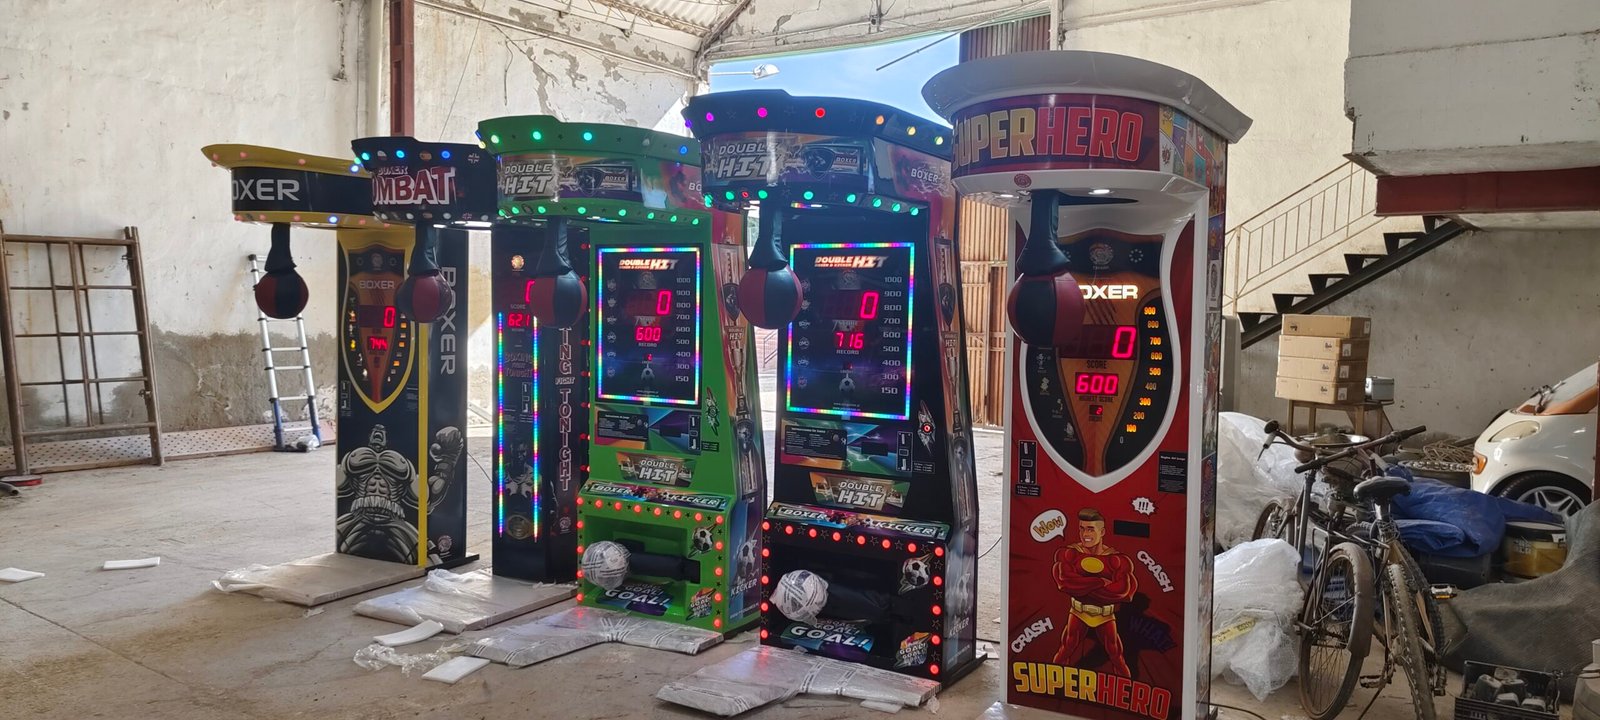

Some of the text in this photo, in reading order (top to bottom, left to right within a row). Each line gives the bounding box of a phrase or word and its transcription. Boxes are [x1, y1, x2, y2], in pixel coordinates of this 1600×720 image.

[719, 142, 778, 155] DOUBLE
[504, 163, 552, 175] DOUBLE
[717, 155, 777, 178] HIT
[911, 168, 939, 183] BOXER
[503, 175, 554, 195] HIT
[649, 259, 679, 270] HIT
[852, 256, 888, 268] HIT
[360, 281, 395, 289] BOXER
[656, 290, 672, 315] 0
[860, 291, 879, 319] 0
[384, 307, 396, 328] 0
[1144, 307, 1156, 315] 900
[508, 313, 531, 328] 621
[635, 327, 662, 342] 600
[836, 332, 864, 349] 716
[883, 331, 901, 339] 600
[1150, 337, 1161, 346] 700
[1112, 326, 1137, 359] 0
[1086, 360, 1108, 369] SCORE
[1149, 368, 1161, 376] 500
[1075, 373, 1119, 395] 600
[1145, 382, 1157, 391] 400
[1139, 397, 1151, 406] 300
[1096, 407, 1103, 415] 2
[1133, 411, 1145, 420] 200
[1126, 424, 1137, 433] 100
[559, 388, 572, 491] TONIGHT
[1119, 436, 1124, 444] 0
[640, 459, 676, 469] DOUBLE
[639, 468, 677, 482] HIT
[840, 481, 883, 492] DOUBLE
[599, 484, 719, 505] BOXER KICKER
[838, 489, 886, 507] HIT
[785, 507, 936, 536] BOXER KICKER
[1137, 550, 1175, 593] CRASH
[731, 579, 758, 597] KICKER
[605, 588, 671, 606] GOAL!
[950, 617, 970, 637] KICKER
[791, 625, 870, 647] GOAL!
[1011, 617, 1054, 654] CRASH
[1012, 661, 1172, 720] SUPERHERO
